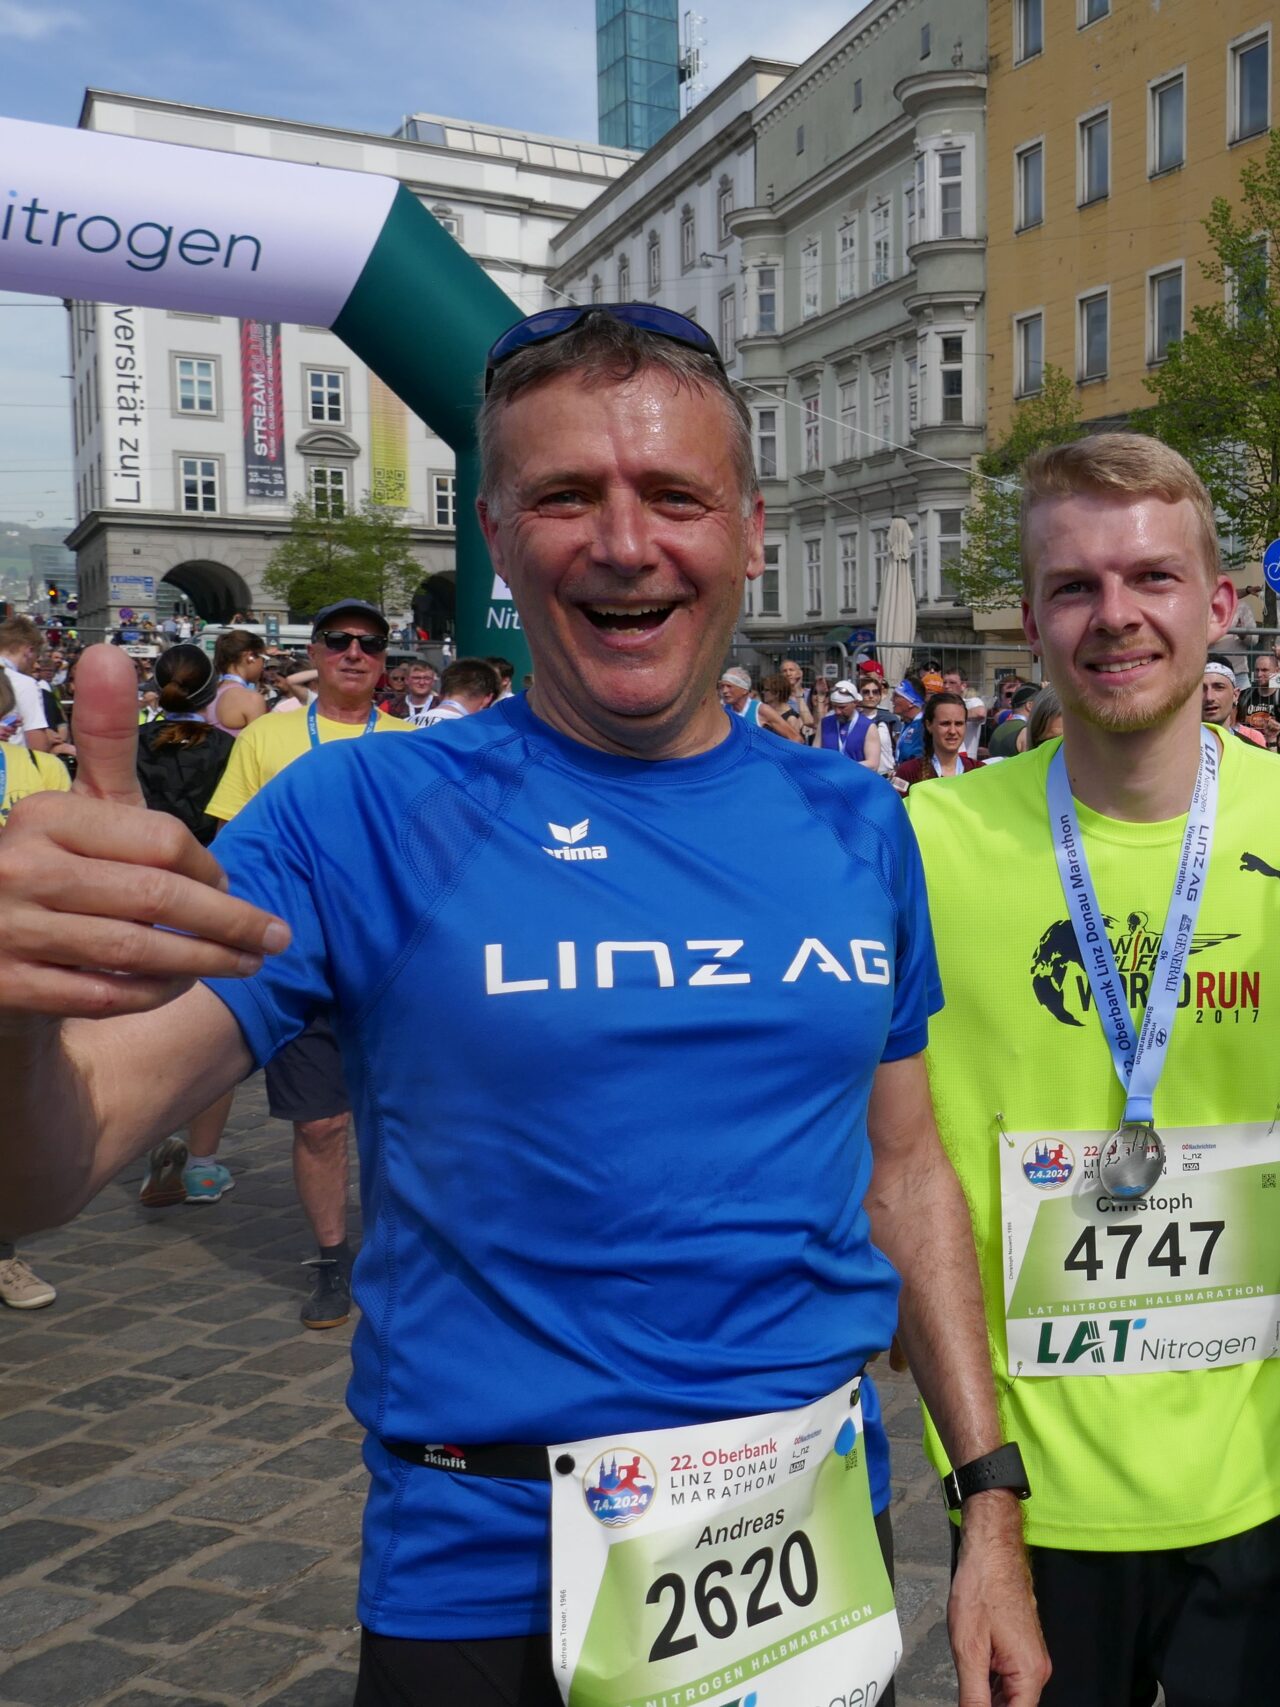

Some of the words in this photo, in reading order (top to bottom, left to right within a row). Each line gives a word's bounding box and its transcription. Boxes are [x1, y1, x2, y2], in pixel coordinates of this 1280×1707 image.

[114, 307, 144, 427] versität
[114, 438, 142, 504] Linz
[1193, 746, 1205, 804] Halbmarathon
[1204, 743, 1217, 781] LAT
[1200, 776, 1212, 813] Nitrogen
[1060, 814, 1085, 890] Marathon
[1175, 825, 1197, 896] Viertelmarathon
[1193, 825, 1210, 870] LINZ
[1186, 872, 1201, 902] AG
[1077, 893, 1100, 944] Donau
[485, 939, 751, 995] LINZ
[782, 937, 891, 986] AG
[1091, 945, 1110, 978] Linz
[1159, 950, 1169, 961] 5k
[1165, 932, 1192, 993] GENERALI
[1076, 971, 1192, 1012] WRD
[1196, 971, 1260, 1009] RUN
[1099, 980, 1132, 1051] Oberbank
[1135, 1006, 1154, 1065] Staffelmarathon
[1195, 1009, 1259, 1024] 2017
[1083, 1146, 1099, 1157] 22
[1028, 1168, 1069, 1179] 7.4.2024
[1064, 1220, 1226, 1281] 4747
[1028, 1305, 1054, 1315] LAT
[1062, 1298, 1138, 1313] NITROGEN
[1146, 1284, 1265, 1306] HALBMARATHON
[1036, 1318, 1133, 1364] LAT
[1140, 1335, 1257, 1362] Nitrogen
[424, 1453, 467, 1470] skinfit
[670, 1455, 698, 1472] 22.
[702, 1437, 777, 1468] Oberbank
[671, 1471, 713, 1488] LINZ
[724, 1457, 779, 1482] DONAU
[593, 1492, 648, 1512] 7.4.2024
[671, 1473, 776, 1506] MARATHON
[695, 1507, 785, 1549] Andreas
[645, 1529, 819, 1663] 2620
[560, 1638, 568, 1670] Andreas
[751, 1603, 874, 1671] HALBMARATHON
